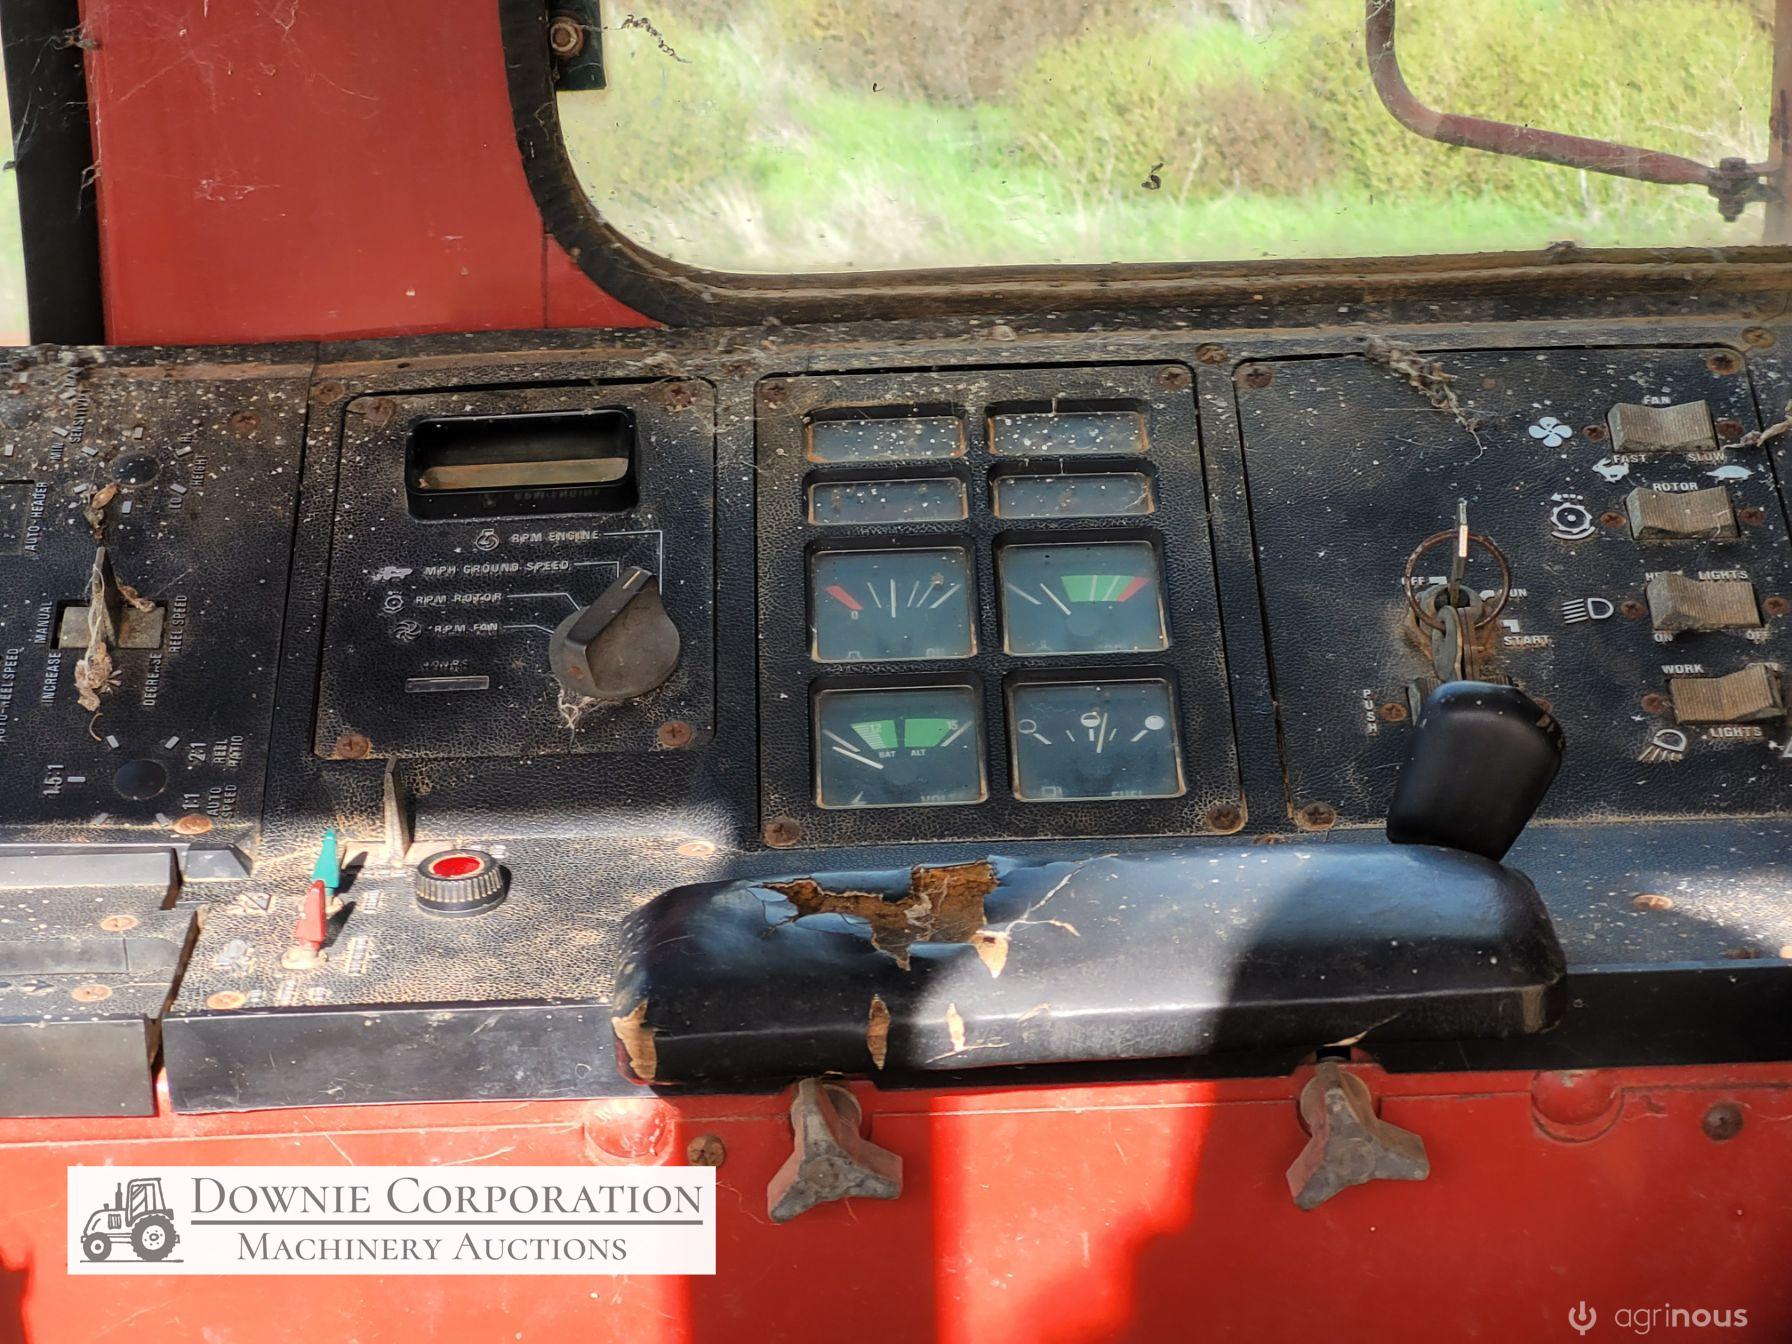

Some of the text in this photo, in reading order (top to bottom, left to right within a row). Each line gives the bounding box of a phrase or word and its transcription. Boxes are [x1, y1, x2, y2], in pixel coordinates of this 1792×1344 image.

[1643, 396, 1671, 405] FAN
[1613, 454, 1646, 464] FAST
[1687, 453, 1725, 462] SLOW
[1653, 482, 1698, 492] ROTOR
[511, 531, 599, 543] RPM ENGINE
[425, 560, 568, 576] MPH GROUND SPEED
[1698, 570, 1749, 580] LIGHTS
[416, 592, 502, 604] RPM ROTOR
[34, 601, 52, 644] MANUAL
[169, 595, 188, 653] REEL SPEED
[434, 622, 498, 633] RPM FAN
[1504, 635, 1550, 646] START
[1654, 633, 1673, 642] ON
[3, 648, 19, 679] SPEED
[1661, 664, 1704, 674] WORK
[41, 652, 61, 703] INCREASE
[1363, 689, 1378, 733] PUSH
[1709, 727, 1763, 738] LIGHTS
[910, 749, 926, 757] ALT
[182, 793, 200, 809] 1:1
[206, 787, 222, 816] AUTO
